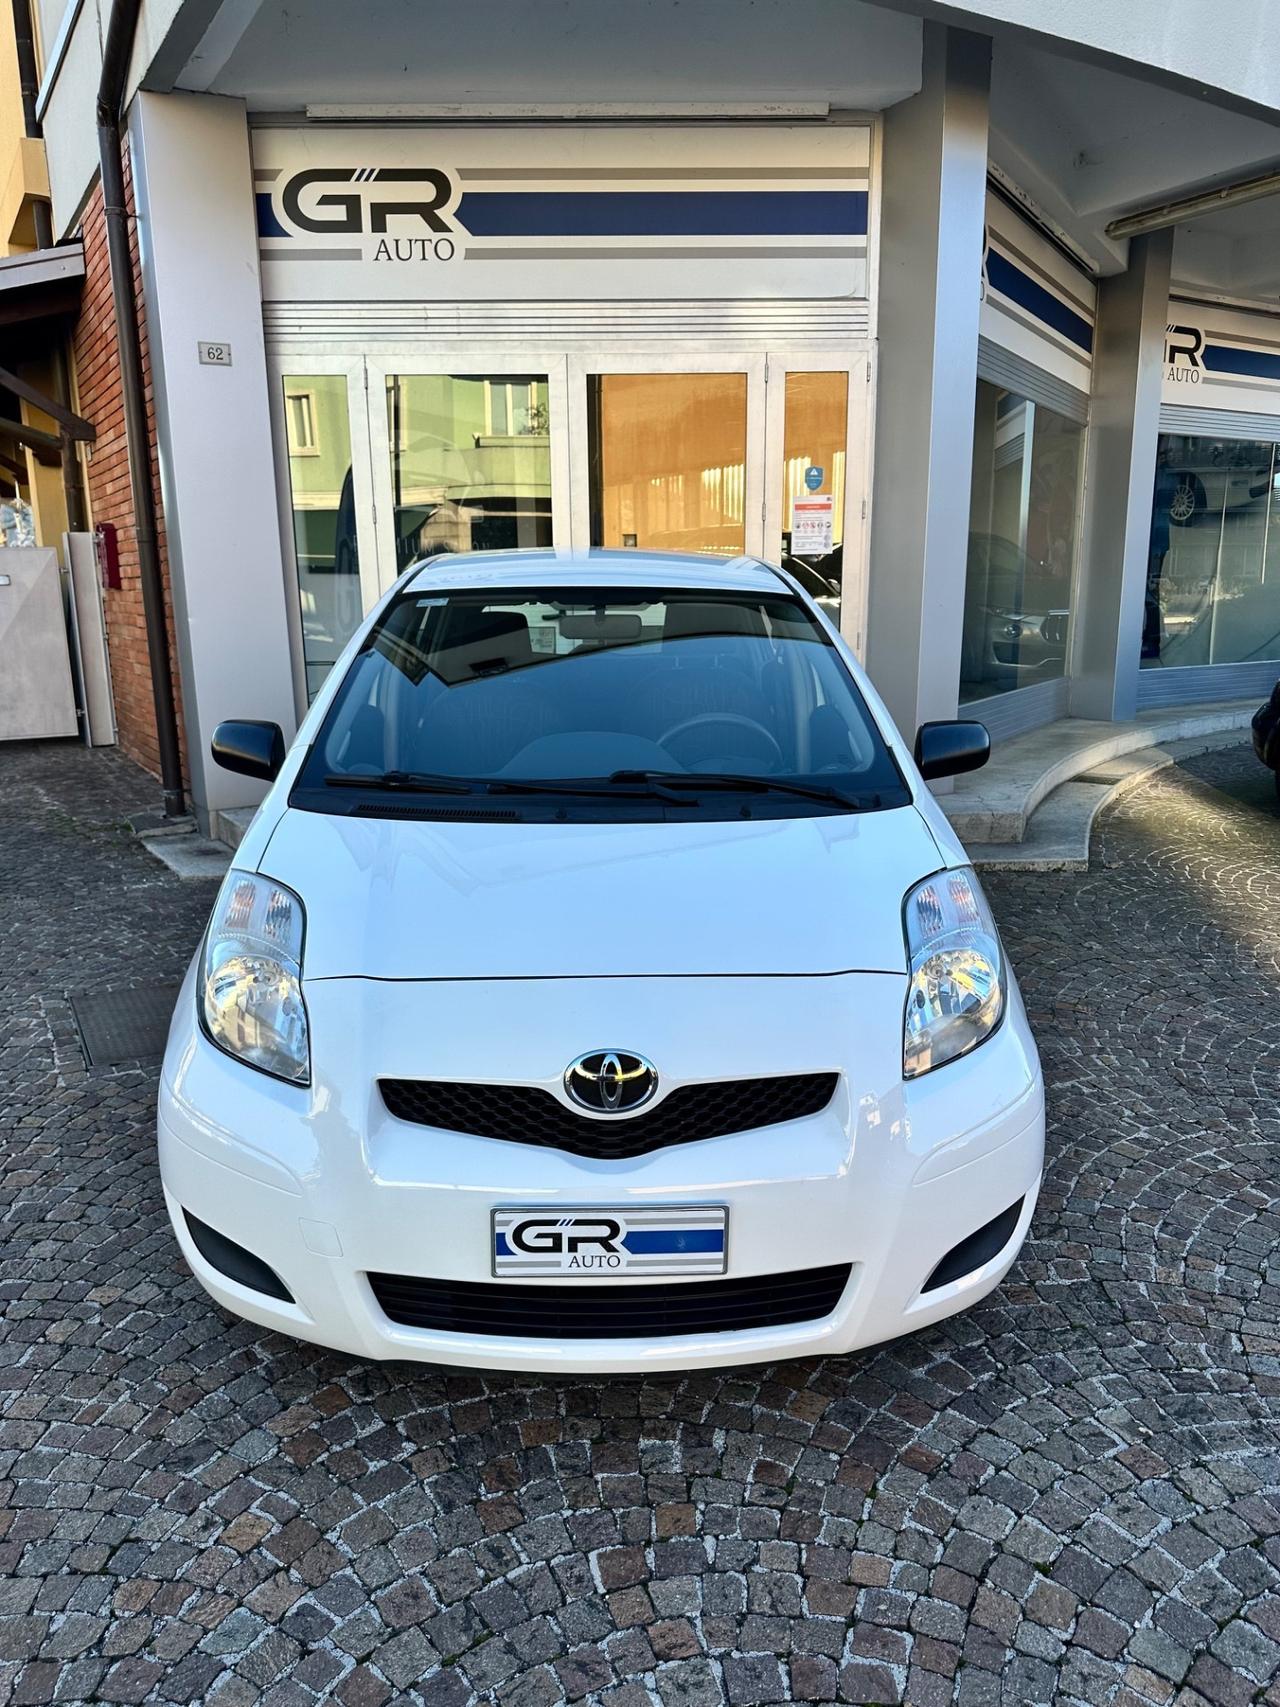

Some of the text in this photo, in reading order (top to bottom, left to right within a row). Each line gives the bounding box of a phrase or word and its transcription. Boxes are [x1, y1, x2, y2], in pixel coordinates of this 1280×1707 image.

[282, 168, 454, 233] GR
[373, 238, 455, 261] AUTO
[207, 346, 224, 360] 62
[1163, 324, 1202, 367] R
[1167, 366, 1200, 383] AUTO
[512, 1218, 621, 1253] GR
[568, 1254, 621, 1268] AUTO
